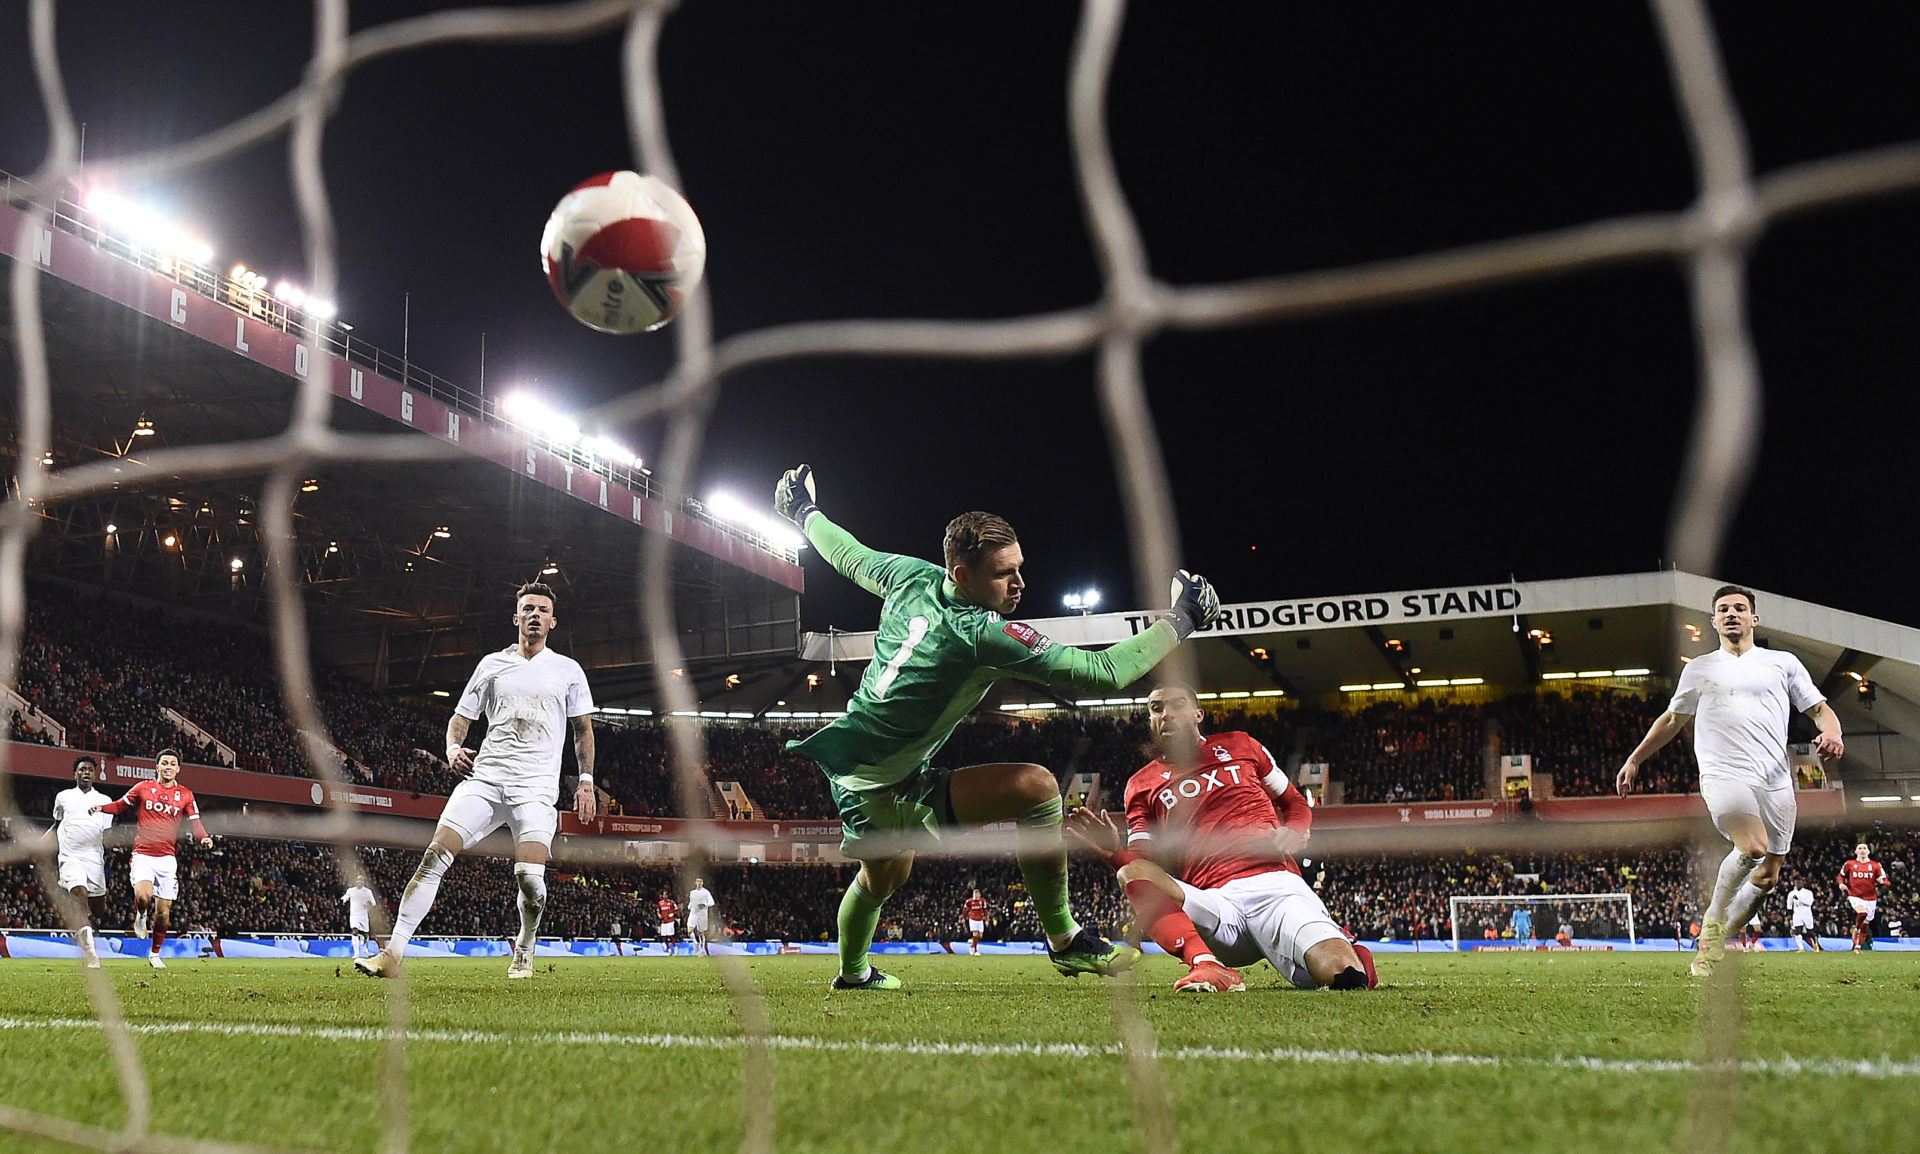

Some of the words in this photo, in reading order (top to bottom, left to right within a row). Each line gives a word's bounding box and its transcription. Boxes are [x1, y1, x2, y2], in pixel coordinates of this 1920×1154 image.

[171, 287, 460, 442] CLOUGH
[526, 449, 673, 535] STAND
[1402, 588, 1522, 617] STAND
[874, 615, 929, 699] 1
[1159, 765, 1240, 810] BOXT
[145, 800, 180, 816] BOXT
[1852, 871, 1874, 879] BOXT
